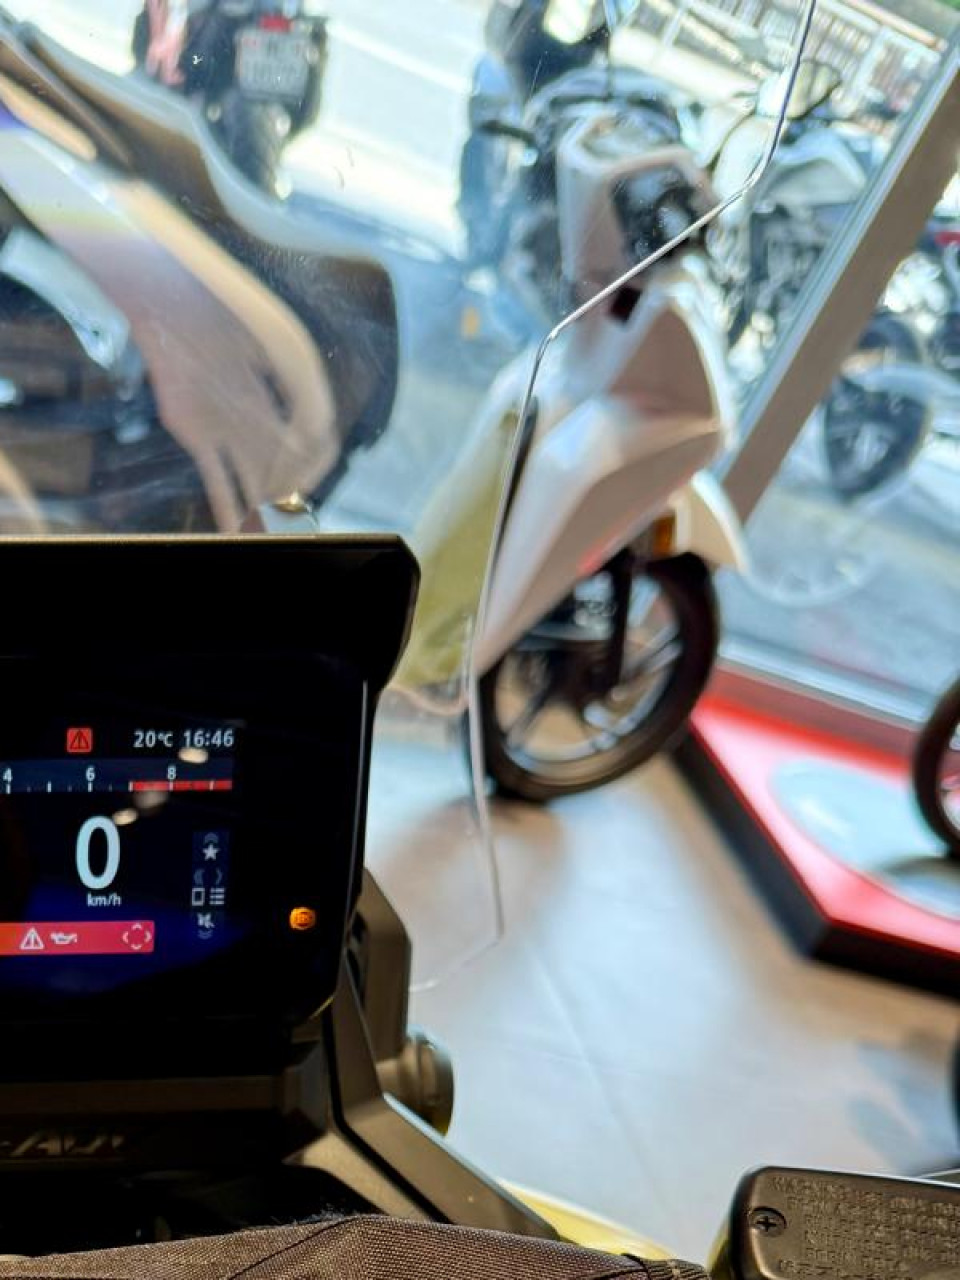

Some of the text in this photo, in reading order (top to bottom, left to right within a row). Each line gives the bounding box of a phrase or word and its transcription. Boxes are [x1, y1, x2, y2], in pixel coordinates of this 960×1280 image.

[183, 728, 235, 748] 16:46
[3, 768, 13, 783] 4
[85, 765, 96, 781] 6
[167, 766, 177, 780] 8
[75, 815, 120, 890] 0
[86, 893, 122, 907] km/h
